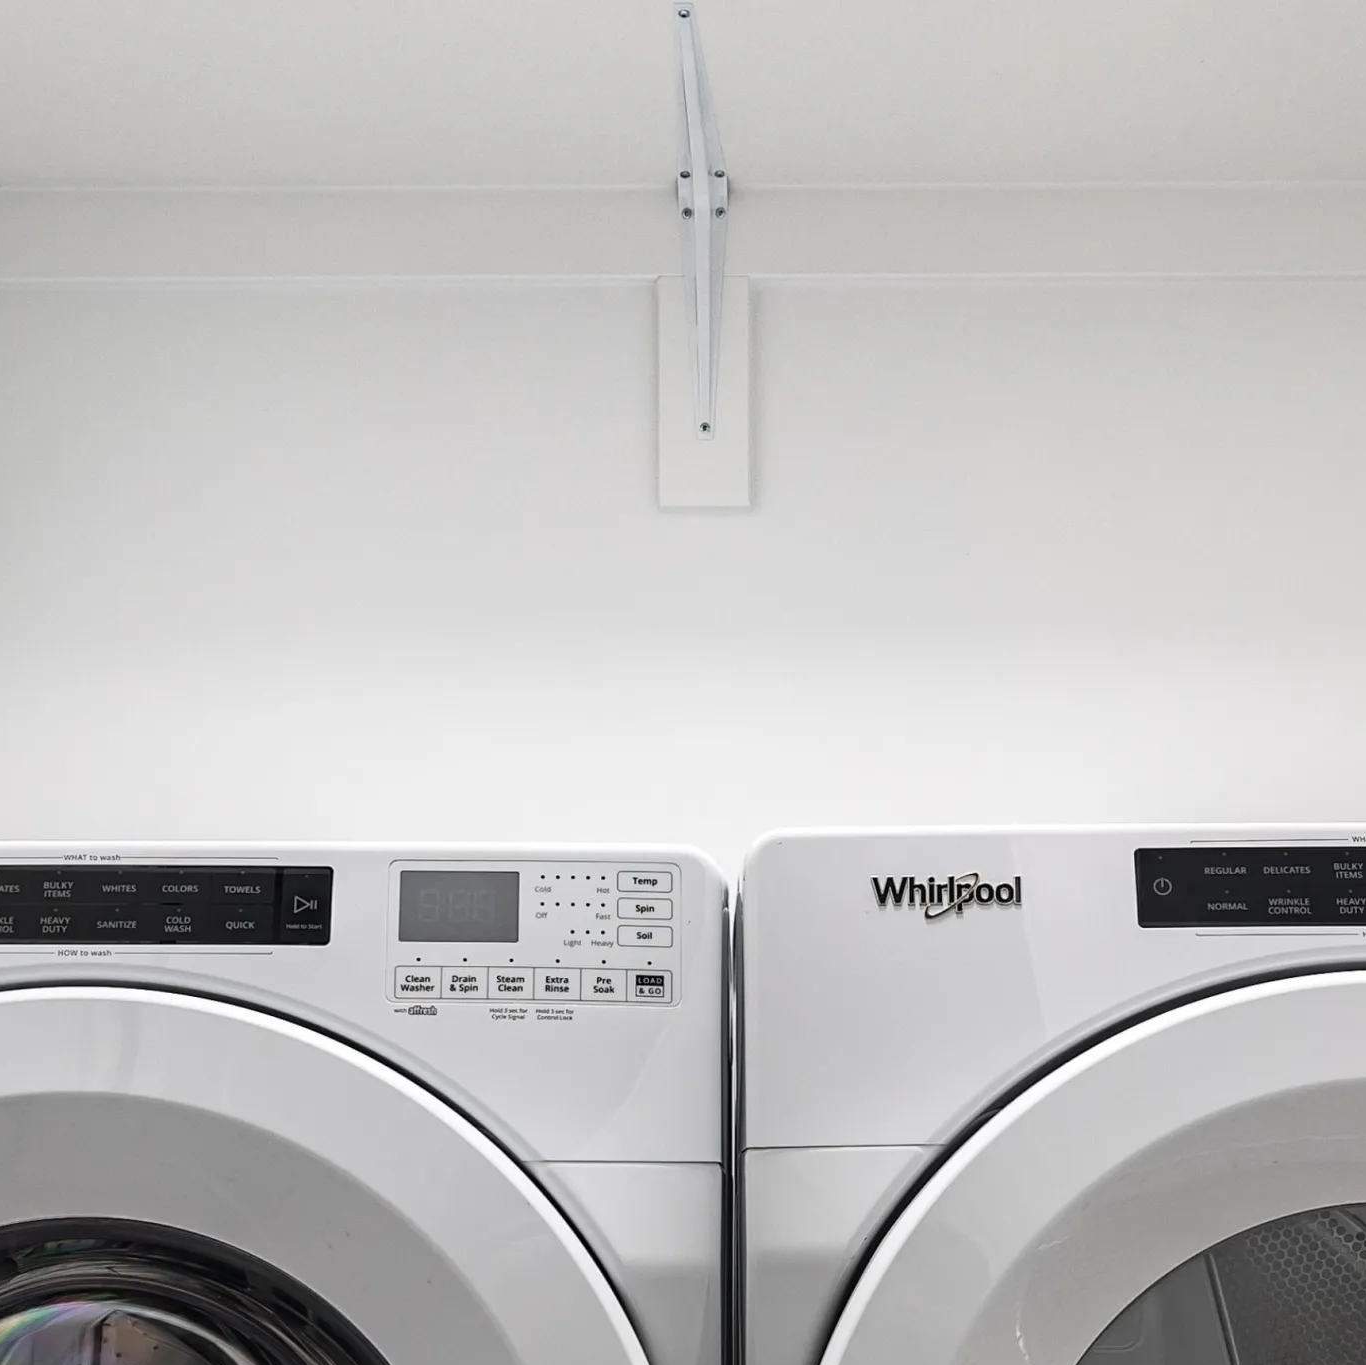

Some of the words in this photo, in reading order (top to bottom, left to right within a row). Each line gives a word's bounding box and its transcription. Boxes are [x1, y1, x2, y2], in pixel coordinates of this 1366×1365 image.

[1263, 866, 1311, 874] DELICATES
[1333, 862, 1363, 870] BULKY
[1204, 866, 1247, 875] REGULAR
[1335, 871, 1363, 879] ITEMS
[43, 881, 73, 889] BULKY
[632, 877, 658, 886] Temp
[101, 884, 137, 893] WHITES
[162, 885, 199, 893] COLORS
[224, 886, 261, 894] TOWELS
[44, 890, 71, 898] ITEMS
[870, 873, 1022, 917] Whirlpool
[1268, 898, 1310, 906] WRINKLE
[1336, 898, 1366, 906] HEAVY
[635, 904, 655, 914] Spin
[1207, 903, 1249, 911] NORMAL
[1268, 906, 1312, 915] CONTROL
[1339, 906, 1365, 914] DUTY
[40, 916, 71, 925] HEAVY
[166, 916, 191, 925] COLD
[41, 925, 67, 933] DUTY
[96, 921, 137, 929] SANITIZE
[164, 925, 192, 933] WASH
[225, 921, 255, 930] QUICK
[636, 931, 652, 940] Soil
[563, 939, 582, 947] Light
[591, 940, 614, 948] Heavy
[405, 975, 431, 983] Clean
[451, 975, 477, 983] Drain
[496, 975, 525, 983] Steam
[545, 976, 569, 984] Extra
[400, 984, 435, 992] Washer
[449, 984, 457, 992] &
[459, 984, 479, 993] Spin
[497, 984, 523, 992] Clean
[593, 986, 615, 994] Soak
